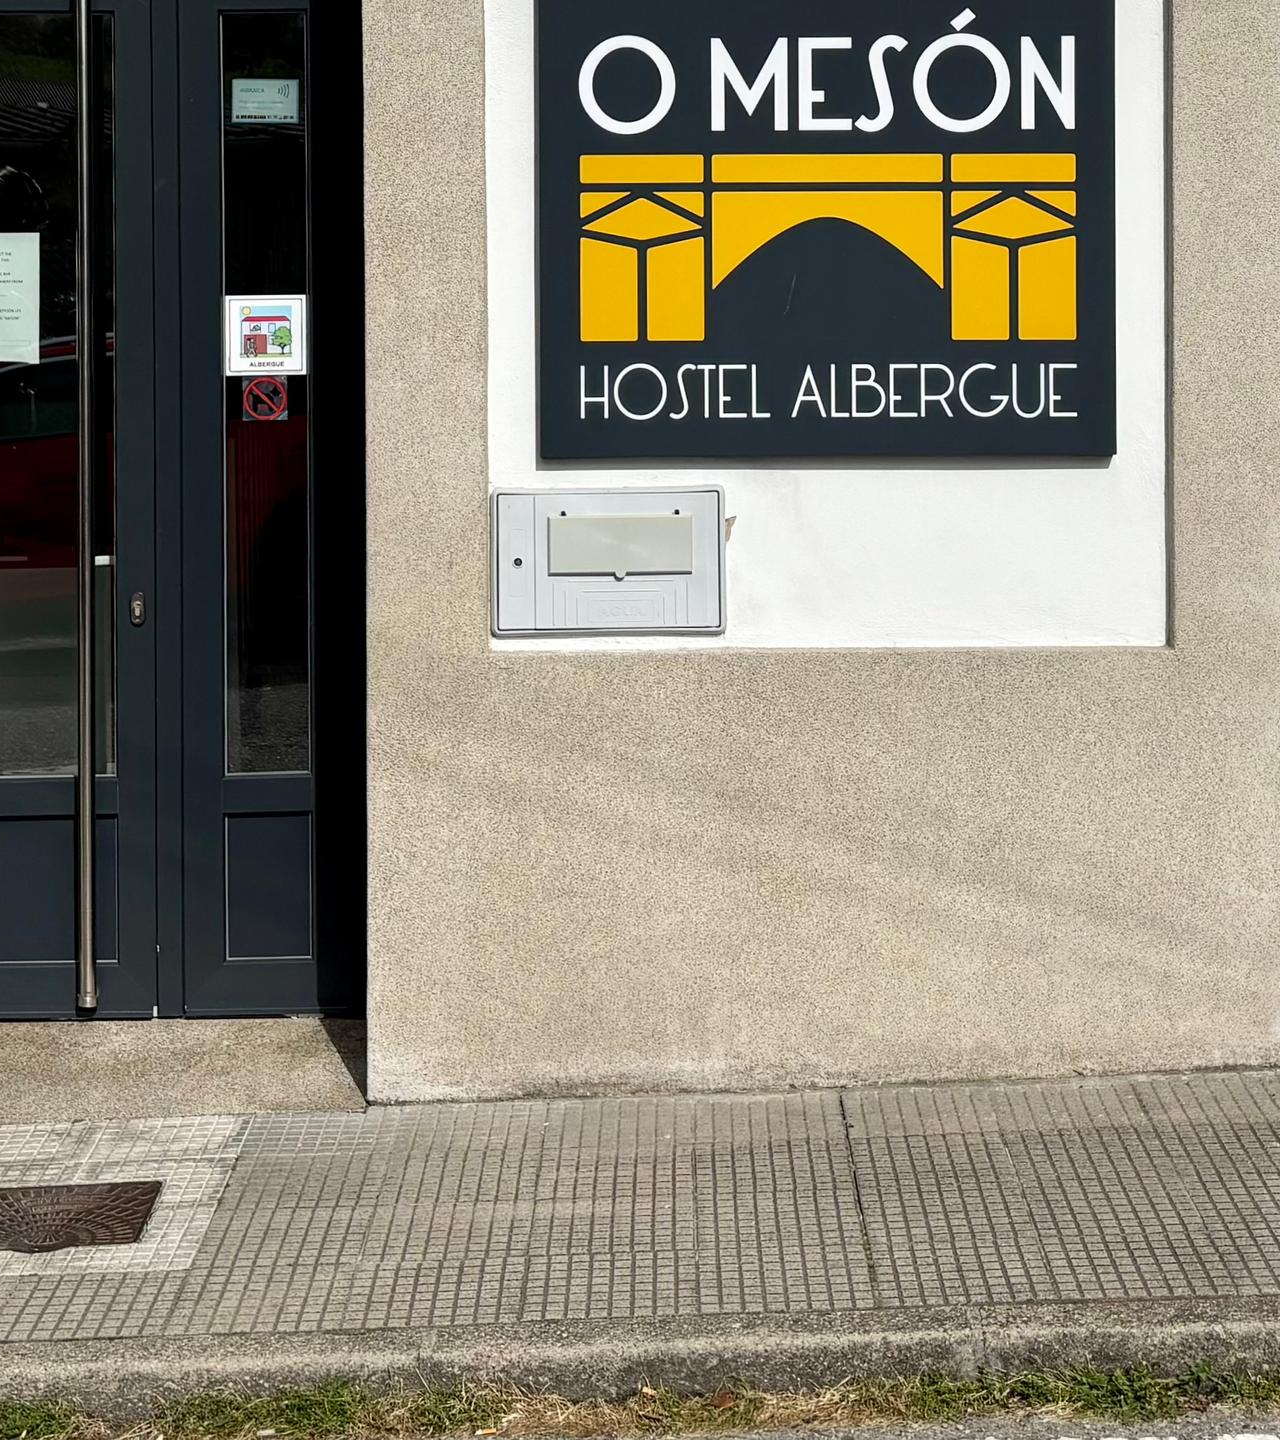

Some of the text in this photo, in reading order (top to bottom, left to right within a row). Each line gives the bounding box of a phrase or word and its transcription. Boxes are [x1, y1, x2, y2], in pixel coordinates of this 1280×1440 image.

[579, 8, 1075, 134] O MESÓN
[580, 363, 1077, 420] HOSTEL ALBERGUE
